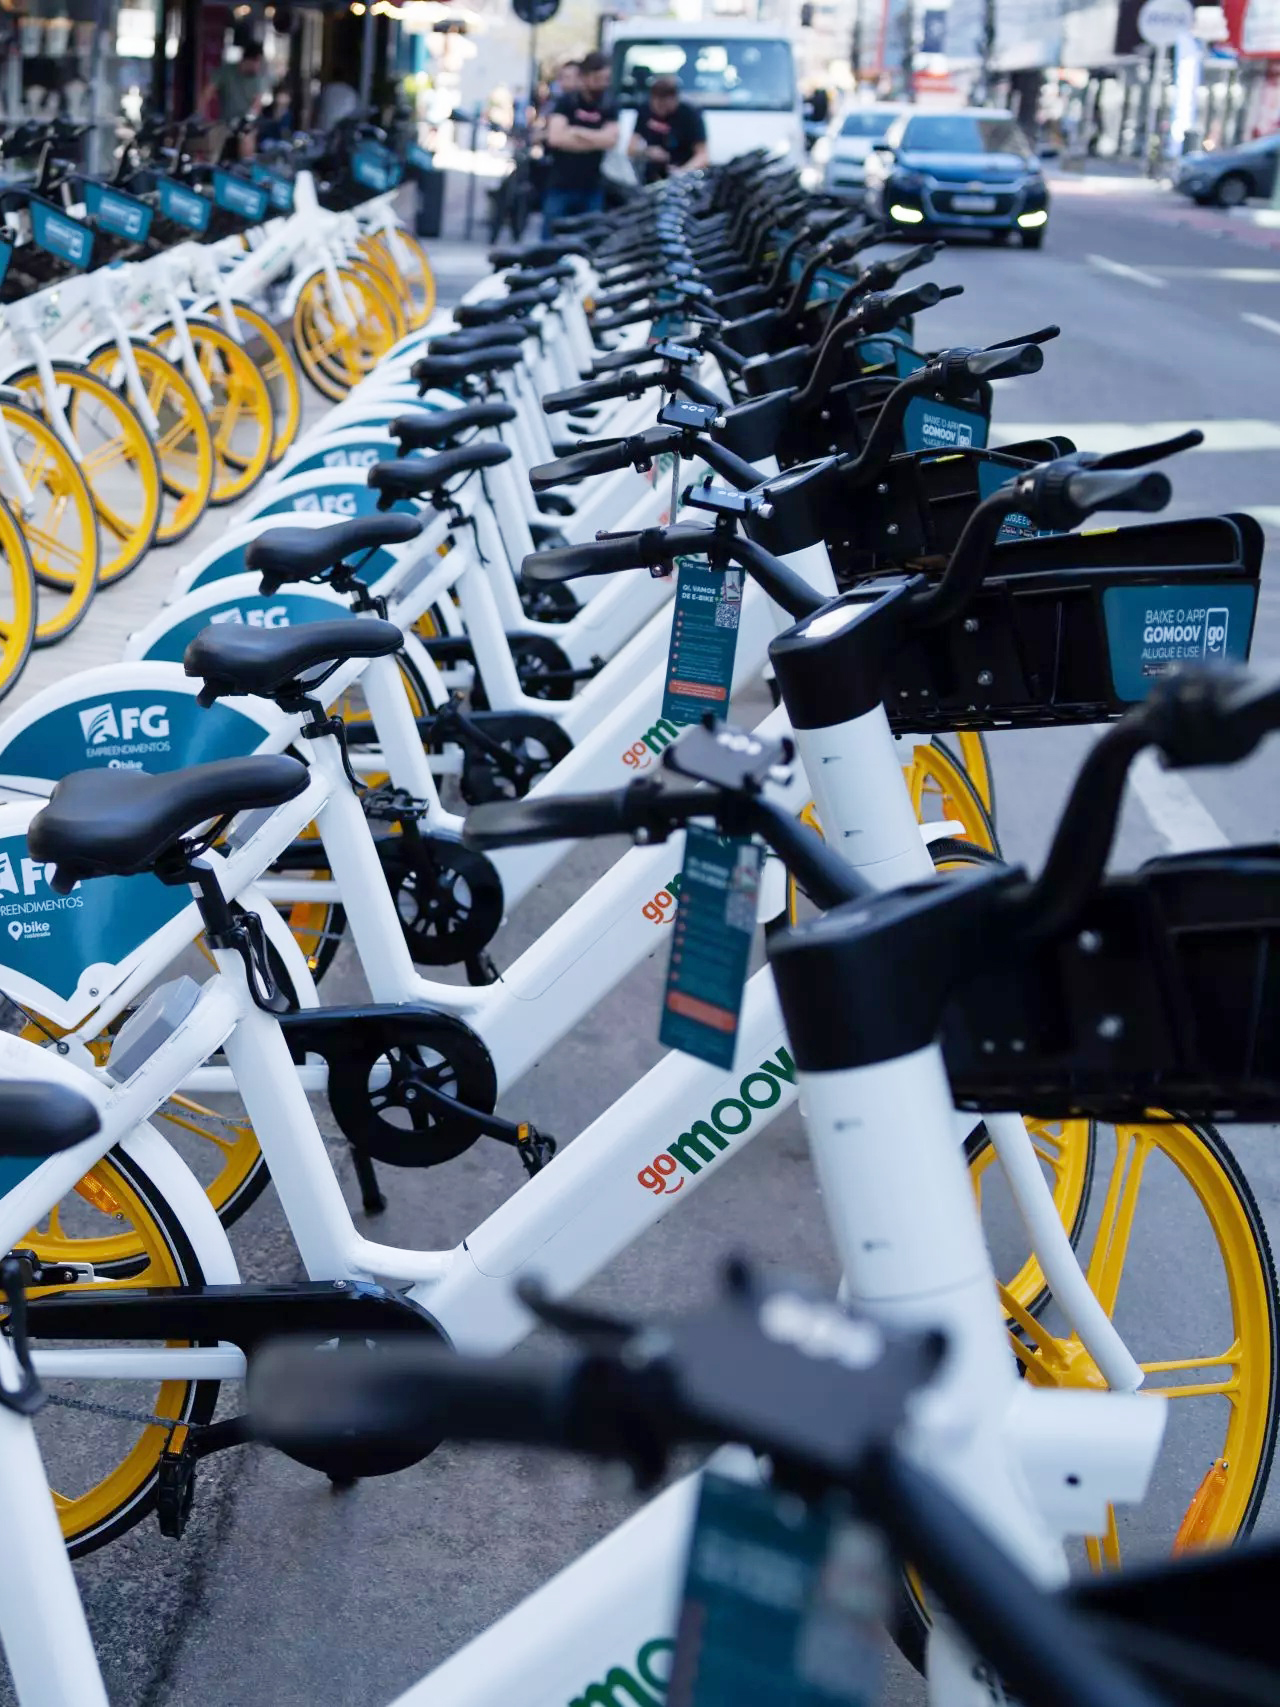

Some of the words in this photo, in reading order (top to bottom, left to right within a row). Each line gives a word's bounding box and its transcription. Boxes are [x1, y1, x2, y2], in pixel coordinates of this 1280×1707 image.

[923, 424, 956, 442] GOMOOV
[350, 449, 380, 467] FG
[322, 493, 357, 515] FG
[247, 606, 290, 629] FG
[1145, 610, 1175, 624] BAIXE
[1177, 609, 1185, 623] O
[1187, 608, 1206, 621] APP
[1143, 625, 1202, 643] GOMOOV
[1207, 626, 1225, 647] go
[1142, 647, 1175, 659] ALUGUE
[1176, 646, 1182, 658] E
[1183, 646, 1200, 658] USE
[121, 705, 170, 740] FG
[86, 741, 172, 758] EMPREENDIMENTOS
[23, 921, 51, 933] bike
[637, 1046, 797, 1195] gomoov
